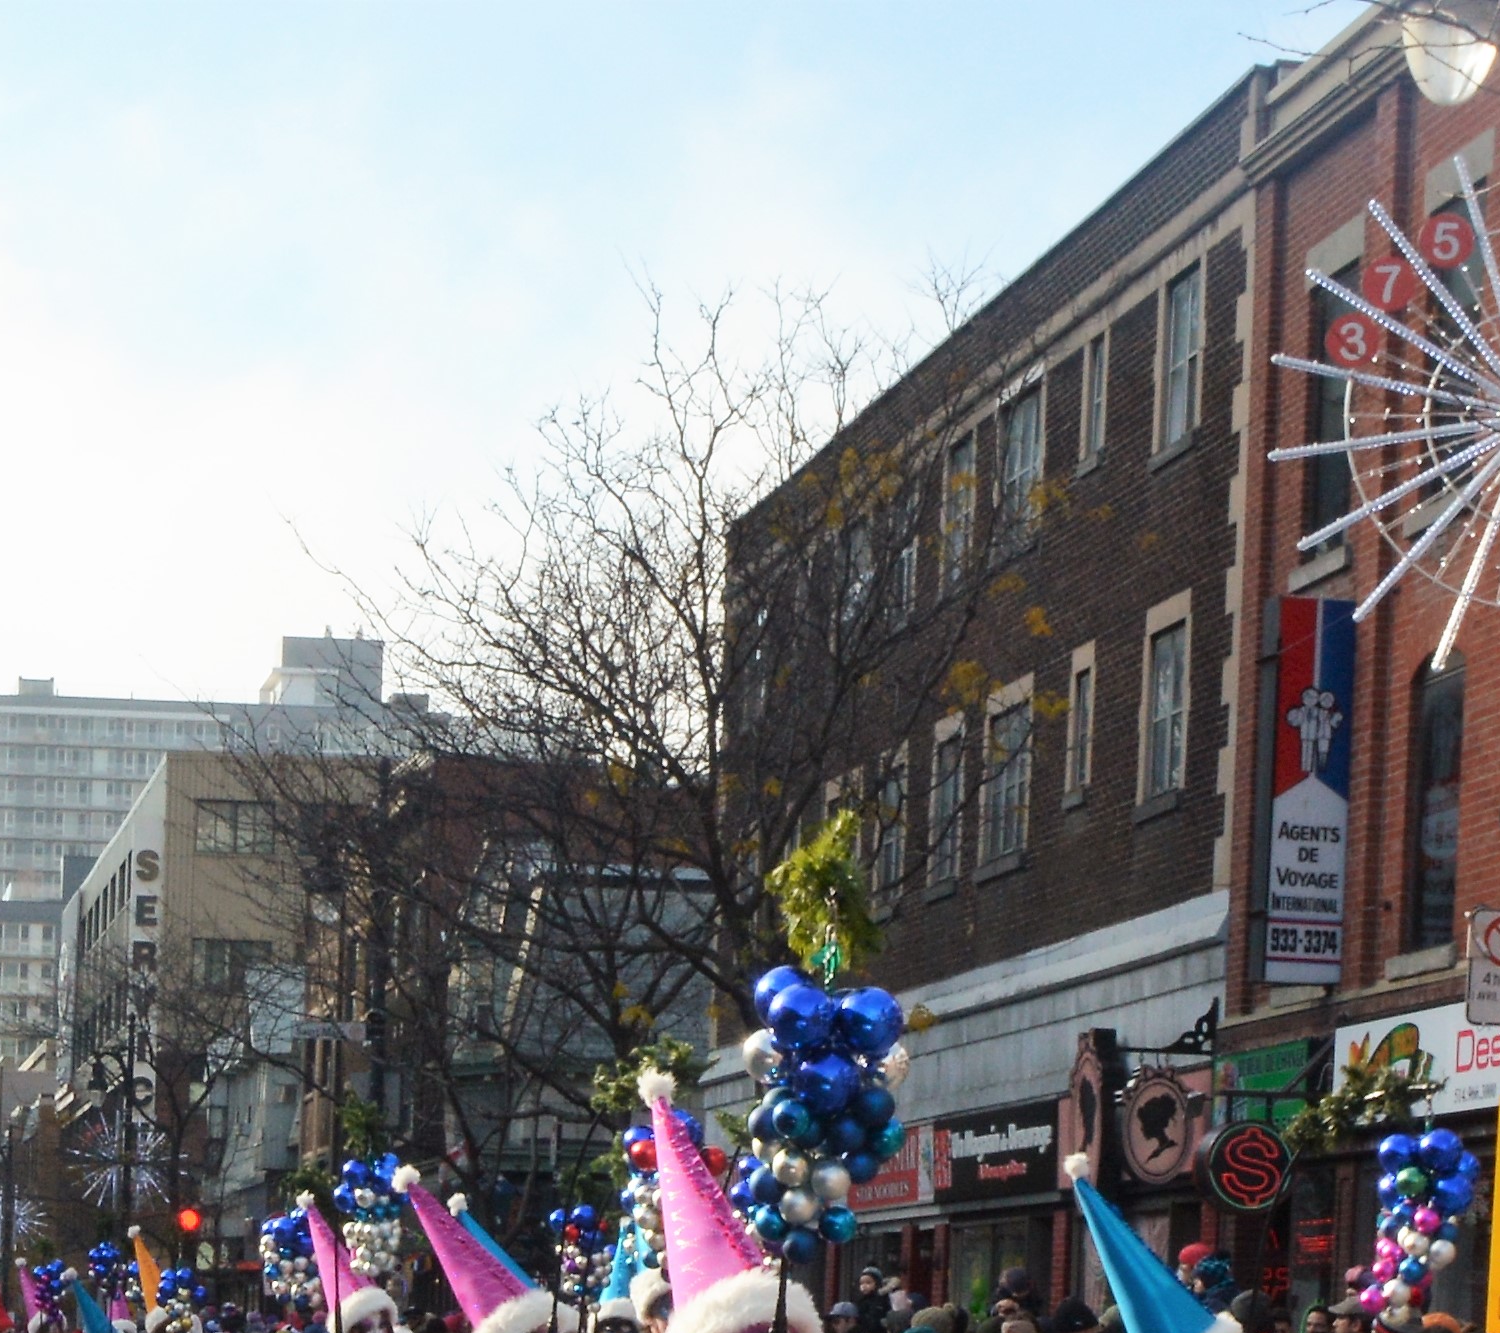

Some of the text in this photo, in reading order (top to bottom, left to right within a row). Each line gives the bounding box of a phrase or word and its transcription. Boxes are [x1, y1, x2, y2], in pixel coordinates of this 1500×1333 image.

[1433, 221, 1459, 261] 5
[1376, 265, 1401, 304] 7
[1340, 321, 1366, 361] 3
[1278, 821, 1341, 843] AGENTS
[1298, 847, 1319, 863] DE
[1276, 867, 1339, 889] VOYAGE
[1270, 928, 1338, 955] 933-3374
